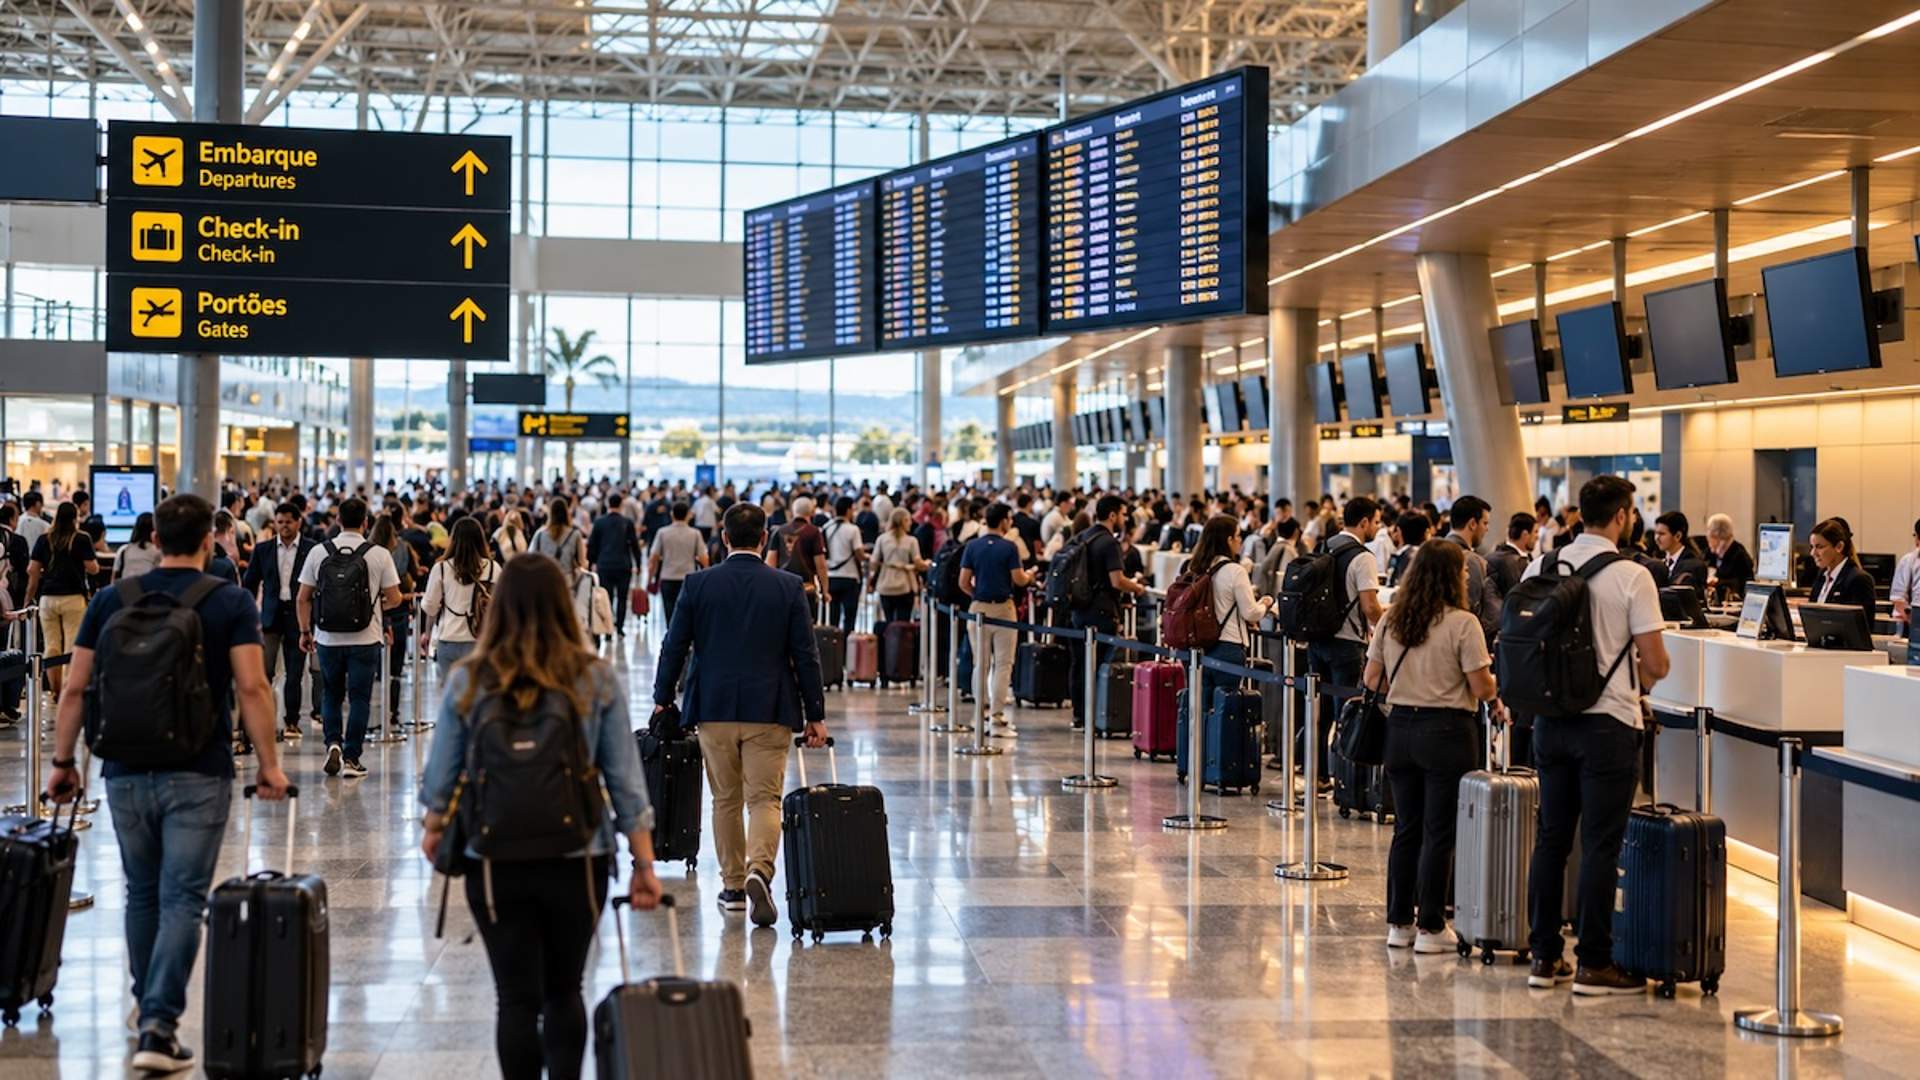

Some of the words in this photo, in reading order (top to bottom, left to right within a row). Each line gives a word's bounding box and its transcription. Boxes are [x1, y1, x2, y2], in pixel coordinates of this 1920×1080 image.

[199, 141, 318, 172] Embarque
[199, 168, 296, 191] Departures
[198, 215, 300, 241] Check-in
[197, 243, 275, 263] Check-in
[198, 291, 287, 316] Portões
[197, 319, 249, 338] Gates
